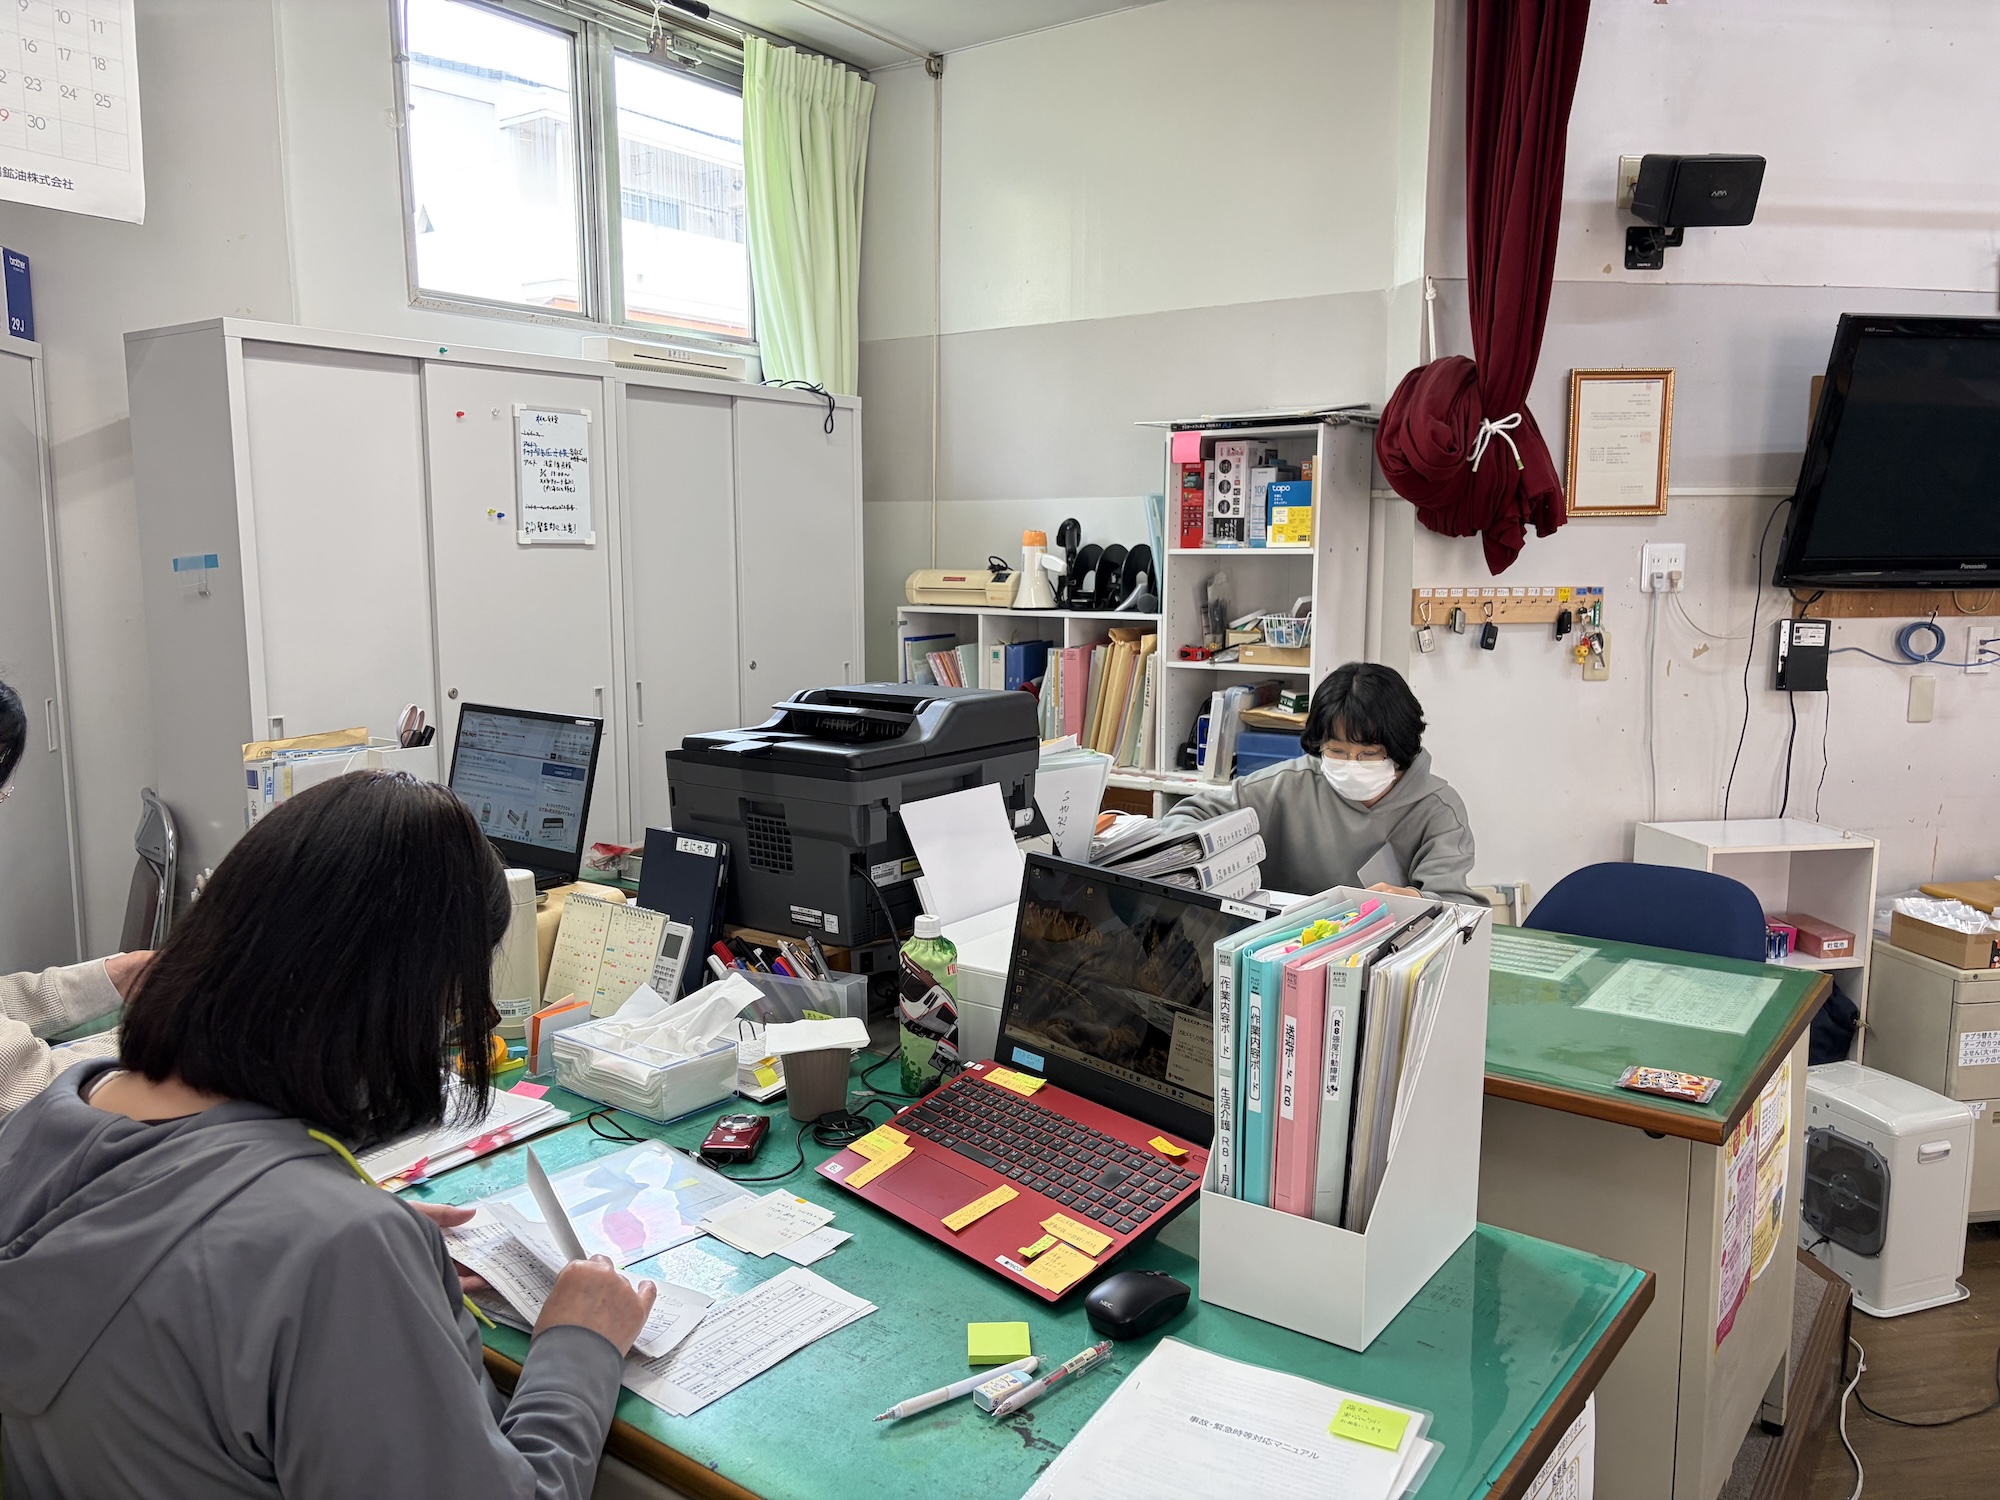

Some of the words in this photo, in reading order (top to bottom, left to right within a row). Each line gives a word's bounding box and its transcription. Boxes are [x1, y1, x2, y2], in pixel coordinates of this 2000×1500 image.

[55, 9, 71, 25] 10
[90, 19, 105, 34] 11
[21, 38, 38, 53] 16
[57, 47, 72, 62] 17
[92, 56, 107, 71] 18
[24, 76, 42, 92] 23
[59, 85, 78, 100] 24
[94, 93, 112, 109] 25
[27, 114, 46, 131] 30
[0, 166, 74, 191] 鉱油株式会社
[9, 255, 26, 270] brother
[11, 317, 25, 332] 29J
[1219, 978, 1231, 1056] 作業内容ボード
[1249, 1013, 1261, 1093] 作業内容ボード
[1284, 1023, 1296, 1079] 送迎ボード
[1329, 1019, 1341, 1083] R8強度行動障害
[1219, 1086, 1231, 1132] 生活介護
[1283, 1085, 1293, 1107] R8
[1221, 1136, 1230, 1157] R8
[1099, 1299, 1114, 1310] NEC
[1189, 1415, 1320, 1460] 事故・緊急時等対応マニュアル
